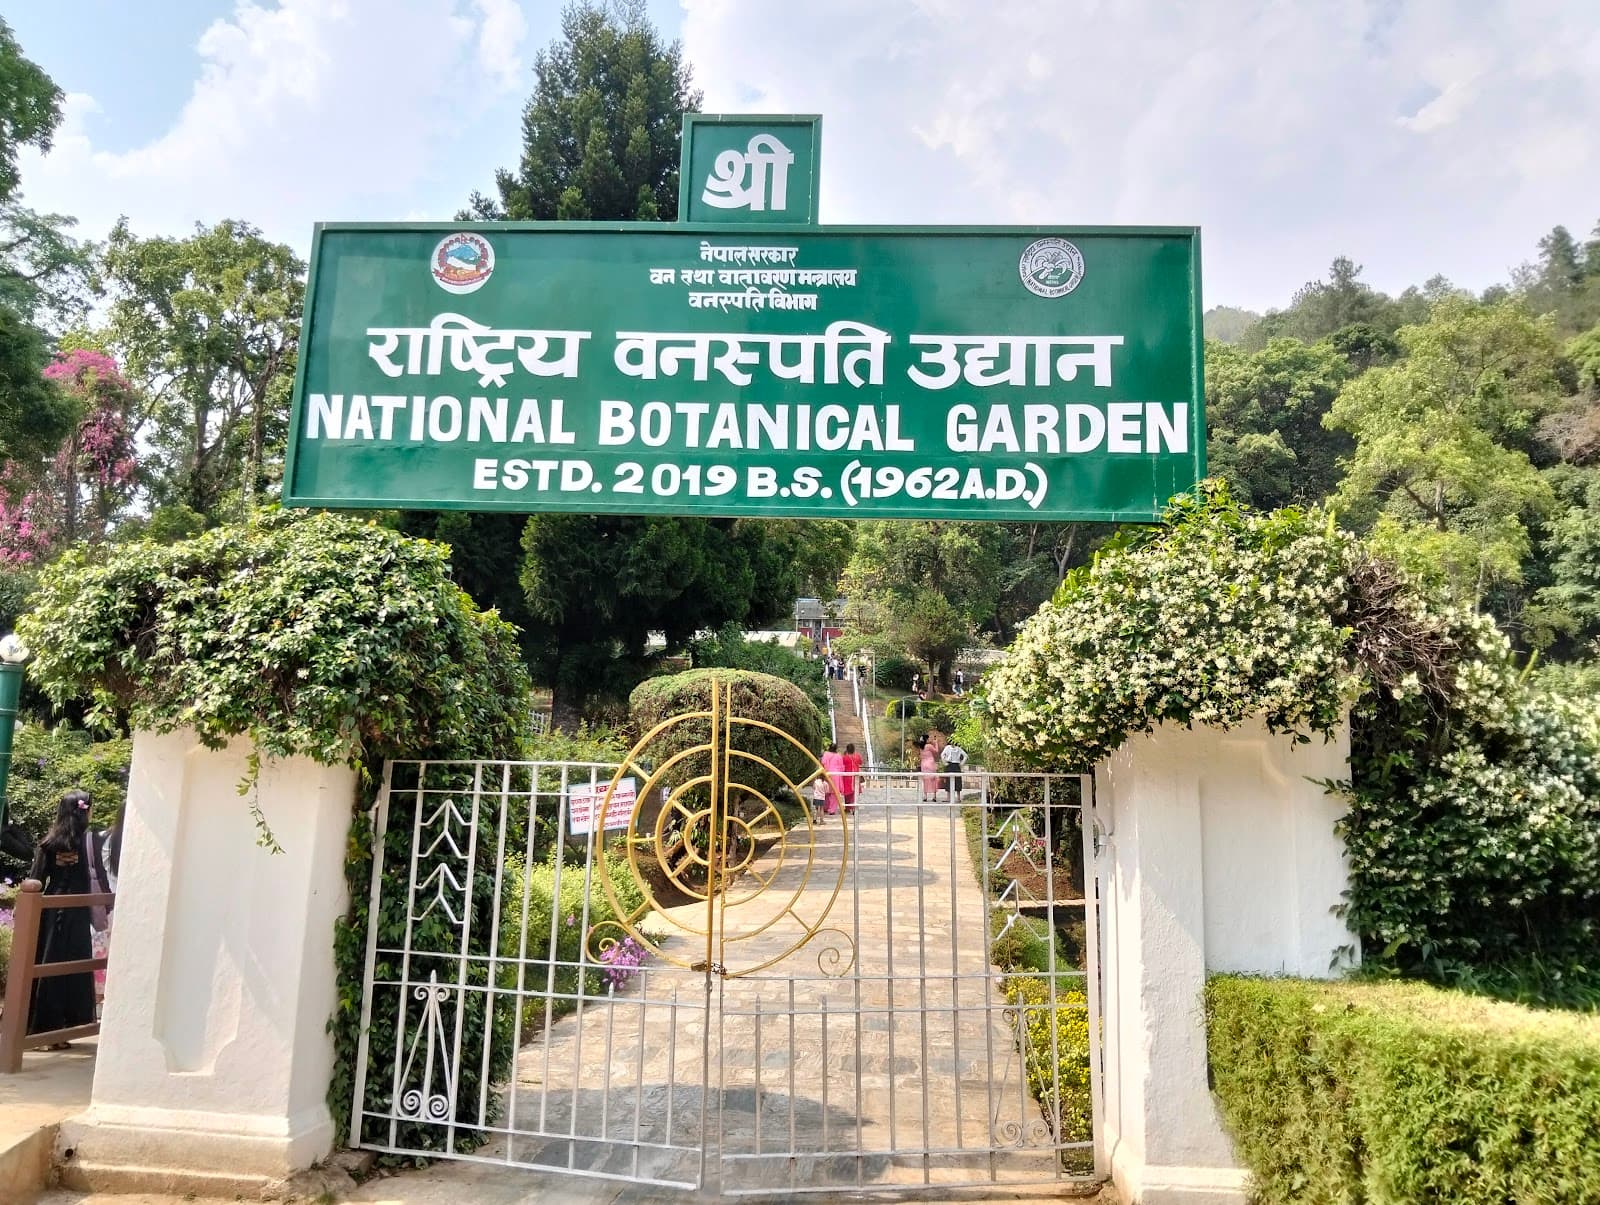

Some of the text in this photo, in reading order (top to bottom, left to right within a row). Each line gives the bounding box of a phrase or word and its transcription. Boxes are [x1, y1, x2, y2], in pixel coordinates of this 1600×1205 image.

[701, 133, 795, 211] श्री
[699, 240, 799, 268] नेपाल सरकार
[649, 268, 675, 285] वन
[680, 269, 715, 287] तथा
[718, 269, 797, 290] वातावरण
[688, 287, 818, 314] वनस्पति विभाग
[365, 312, 1125, 390] राष्ट्रिय वनस्पति उद्यान
[306, 394, 1188, 454] NATIONAL BOTANICAL GARDEN
[473, 458, 603, 494] ESTD.
[613, 462, 738, 497] 2019
[747, 467, 833, 499] B.S.
